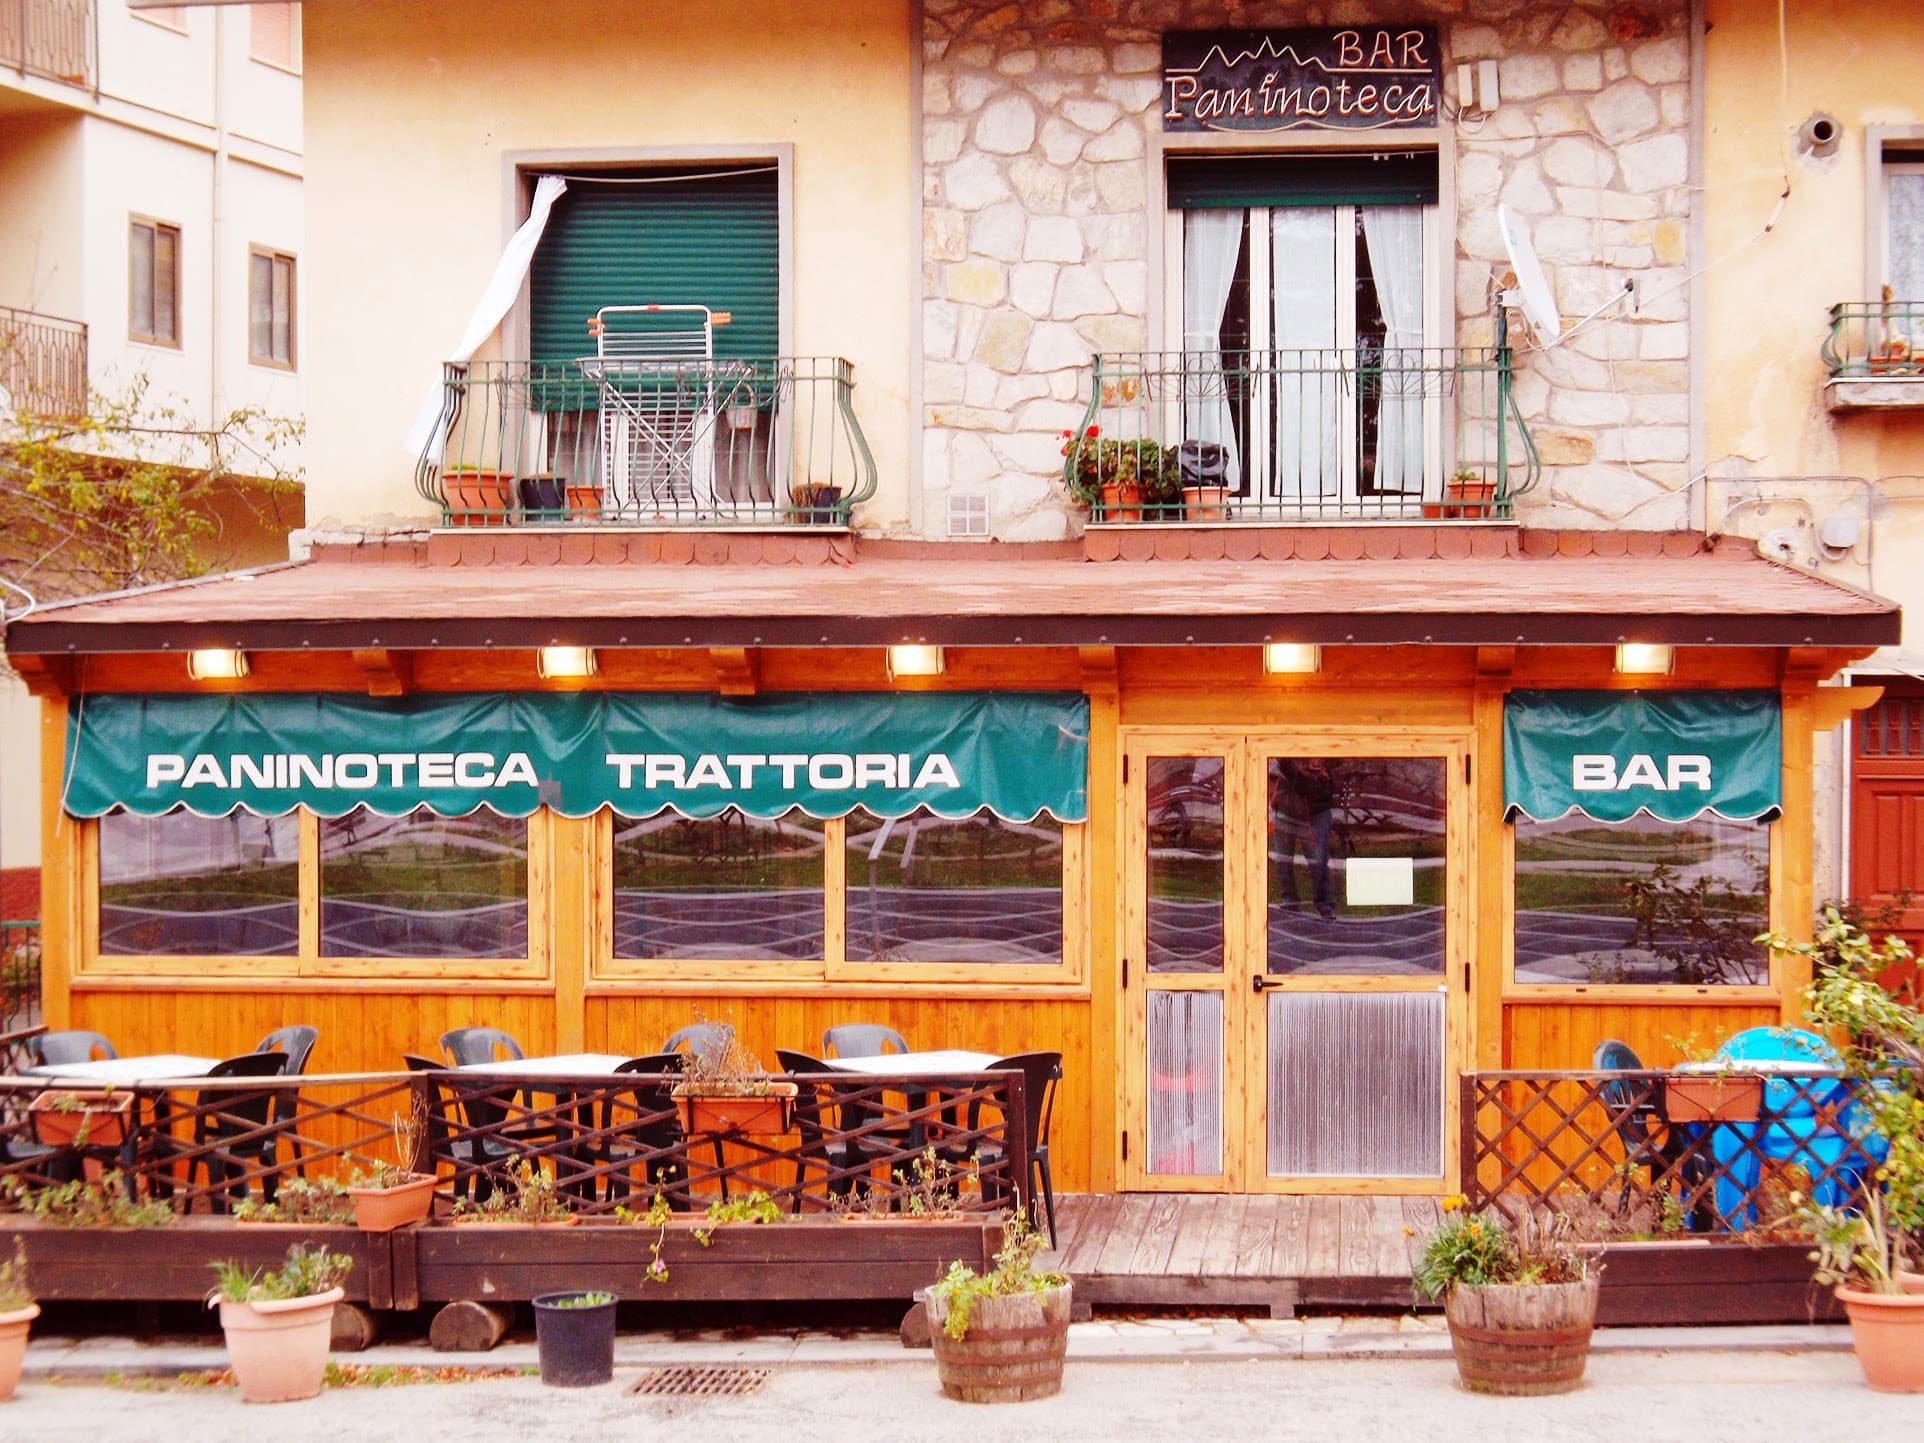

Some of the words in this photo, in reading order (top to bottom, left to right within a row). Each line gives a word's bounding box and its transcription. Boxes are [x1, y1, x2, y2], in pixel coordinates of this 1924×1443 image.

[1333, 30, 1428, 67] BAR
[1165, 69, 1434, 119] Paninoteca
[146, 753, 539, 789] PANINOTECA
[605, 753, 961, 790] TRATTORIA
[1571, 754, 1712, 792] BAR
